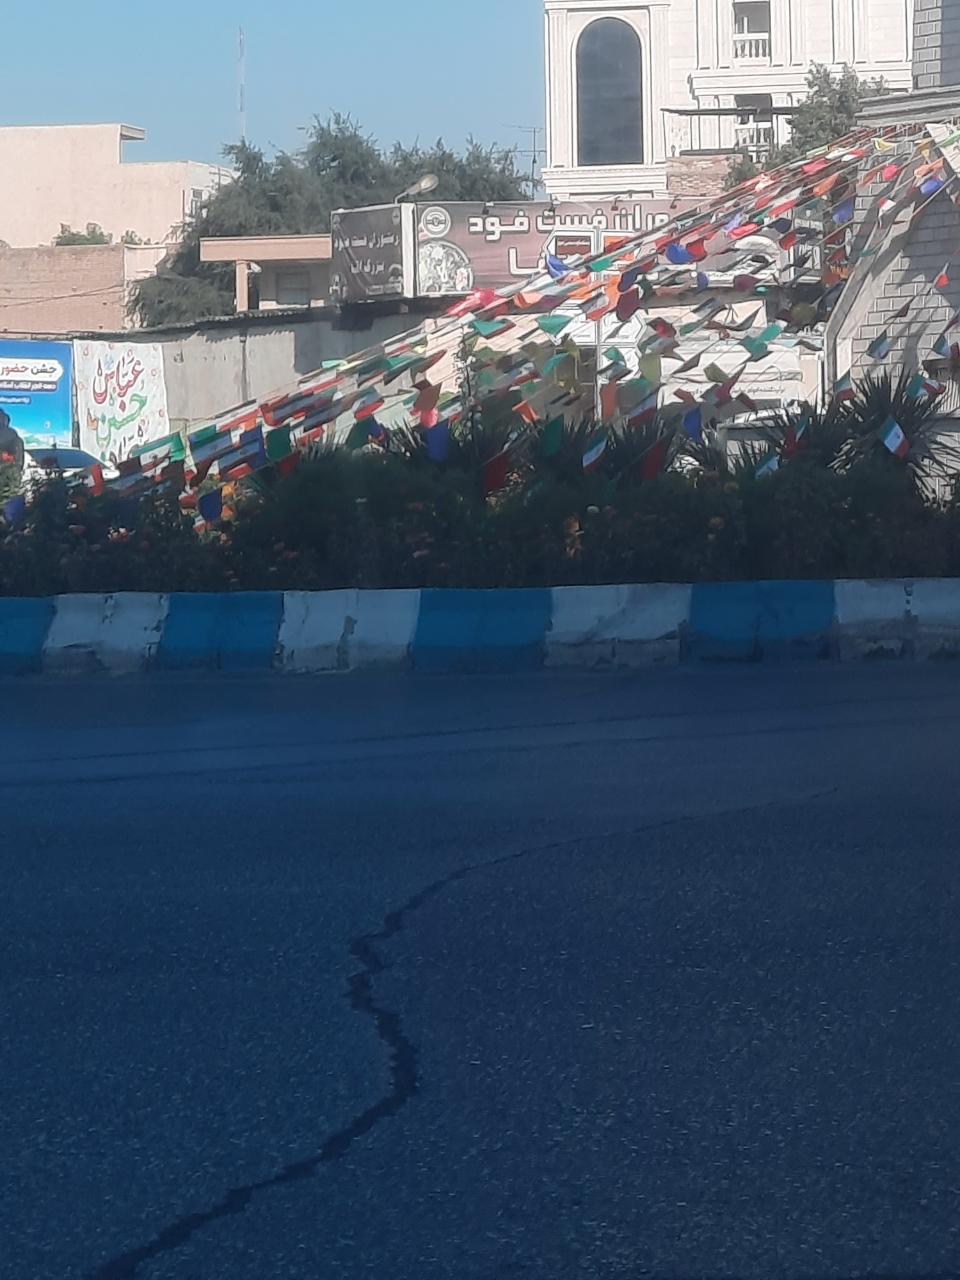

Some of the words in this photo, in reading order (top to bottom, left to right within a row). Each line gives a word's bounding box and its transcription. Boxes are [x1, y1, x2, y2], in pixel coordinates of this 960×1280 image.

[468, 209, 530, 241] فود
[537, 208, 608, 232] فست
[31, 363, 57, 378] جشن
